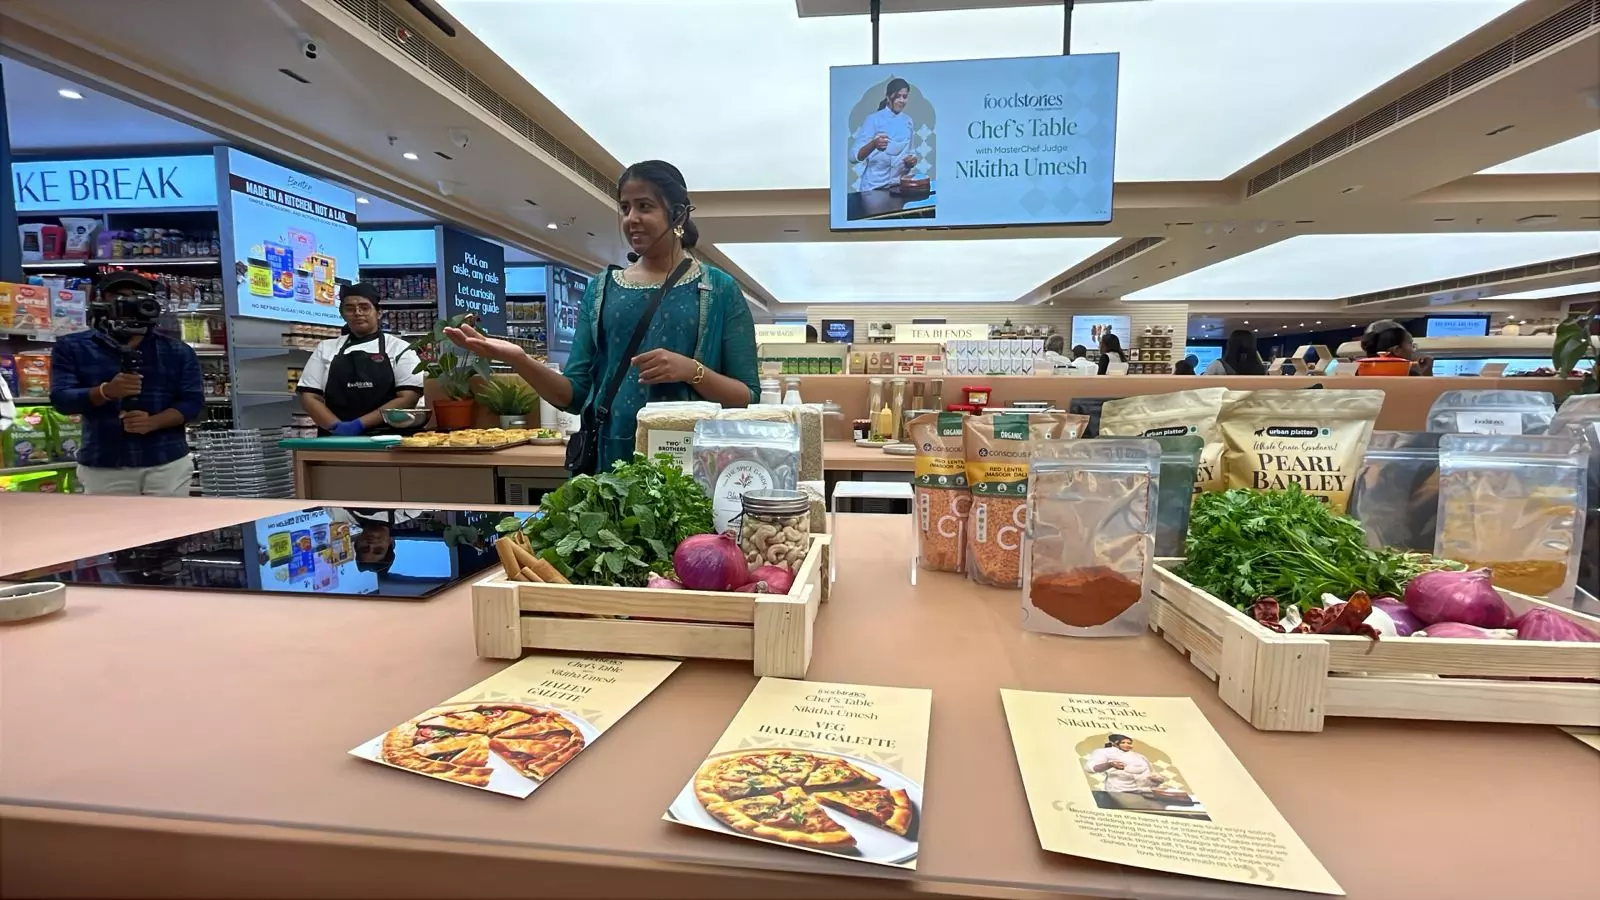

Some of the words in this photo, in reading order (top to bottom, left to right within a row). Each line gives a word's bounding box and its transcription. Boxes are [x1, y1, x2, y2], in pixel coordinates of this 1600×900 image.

[984, 92, 1063, 109] foodstories
[968, 118, 1024, 140] Chef's
[1028, 117, 1078, 137] Table
[976, 146, 992, 154] with
[994, 145, 1040, 154] MasterChef
[1042, 144, 1068, 154] Judge
[956, 158, 1019, 178] Nikitha
[1024, 156, 1086, 176] Umesh
[69, 166, 183, 200] BREAK
[246, 181, 268, 199] MADE
[268, 189, 276, 200] IN
[278, 192, 284, 202] A
[315, 204, 328, 216] NOT
[328, 208, 334, 218] A
[465, 252, 478, 266] Pick
[479, 260, 488, 269] an
[452, 263, 470, 278] aisle,
[472, 270, 484, 283] any
[485, 272, 499, 284] aisle
[458, 282, 469, 295] Let
[470, 288, 496, 301] curiosity
[454, 294, 464, 307] be
[466, 300, 481, 312] your
[482, 301, 499, 315] guide
[912, 329, 930, 338] TEA
[933, 329, 972, 338] BLENDS
[1000, 431, 1023, 440] ORGANIC
[1258, 453, 1340, 472] PEARL
[1252, 470, 1348, 492] BARLEY
[567, 661, 596, 671] Chef's
[598, 662, 624, 673] Table
[527, 687, 585, 702] GALETTE
[540, 680, 593, 694] HALEEM
[805, 695, 840, 704] Chef's
[844, 697, 874, 707] Table
[792, 705, 833, 716] Nikitha
[835, 710, 879, 720] Umesh
[1061, 705, 1107, 716] Chef's
[1109, 708, 1148, 717] Table
[815, 721, 846, 732] VEG
[1057, 716, 1109, 729] Nikitha
[1111, 721, 1167, 734] Umesh
[758, 724, 822, 740] HALEEM
[825, 732, 897, 749] GALETTE
